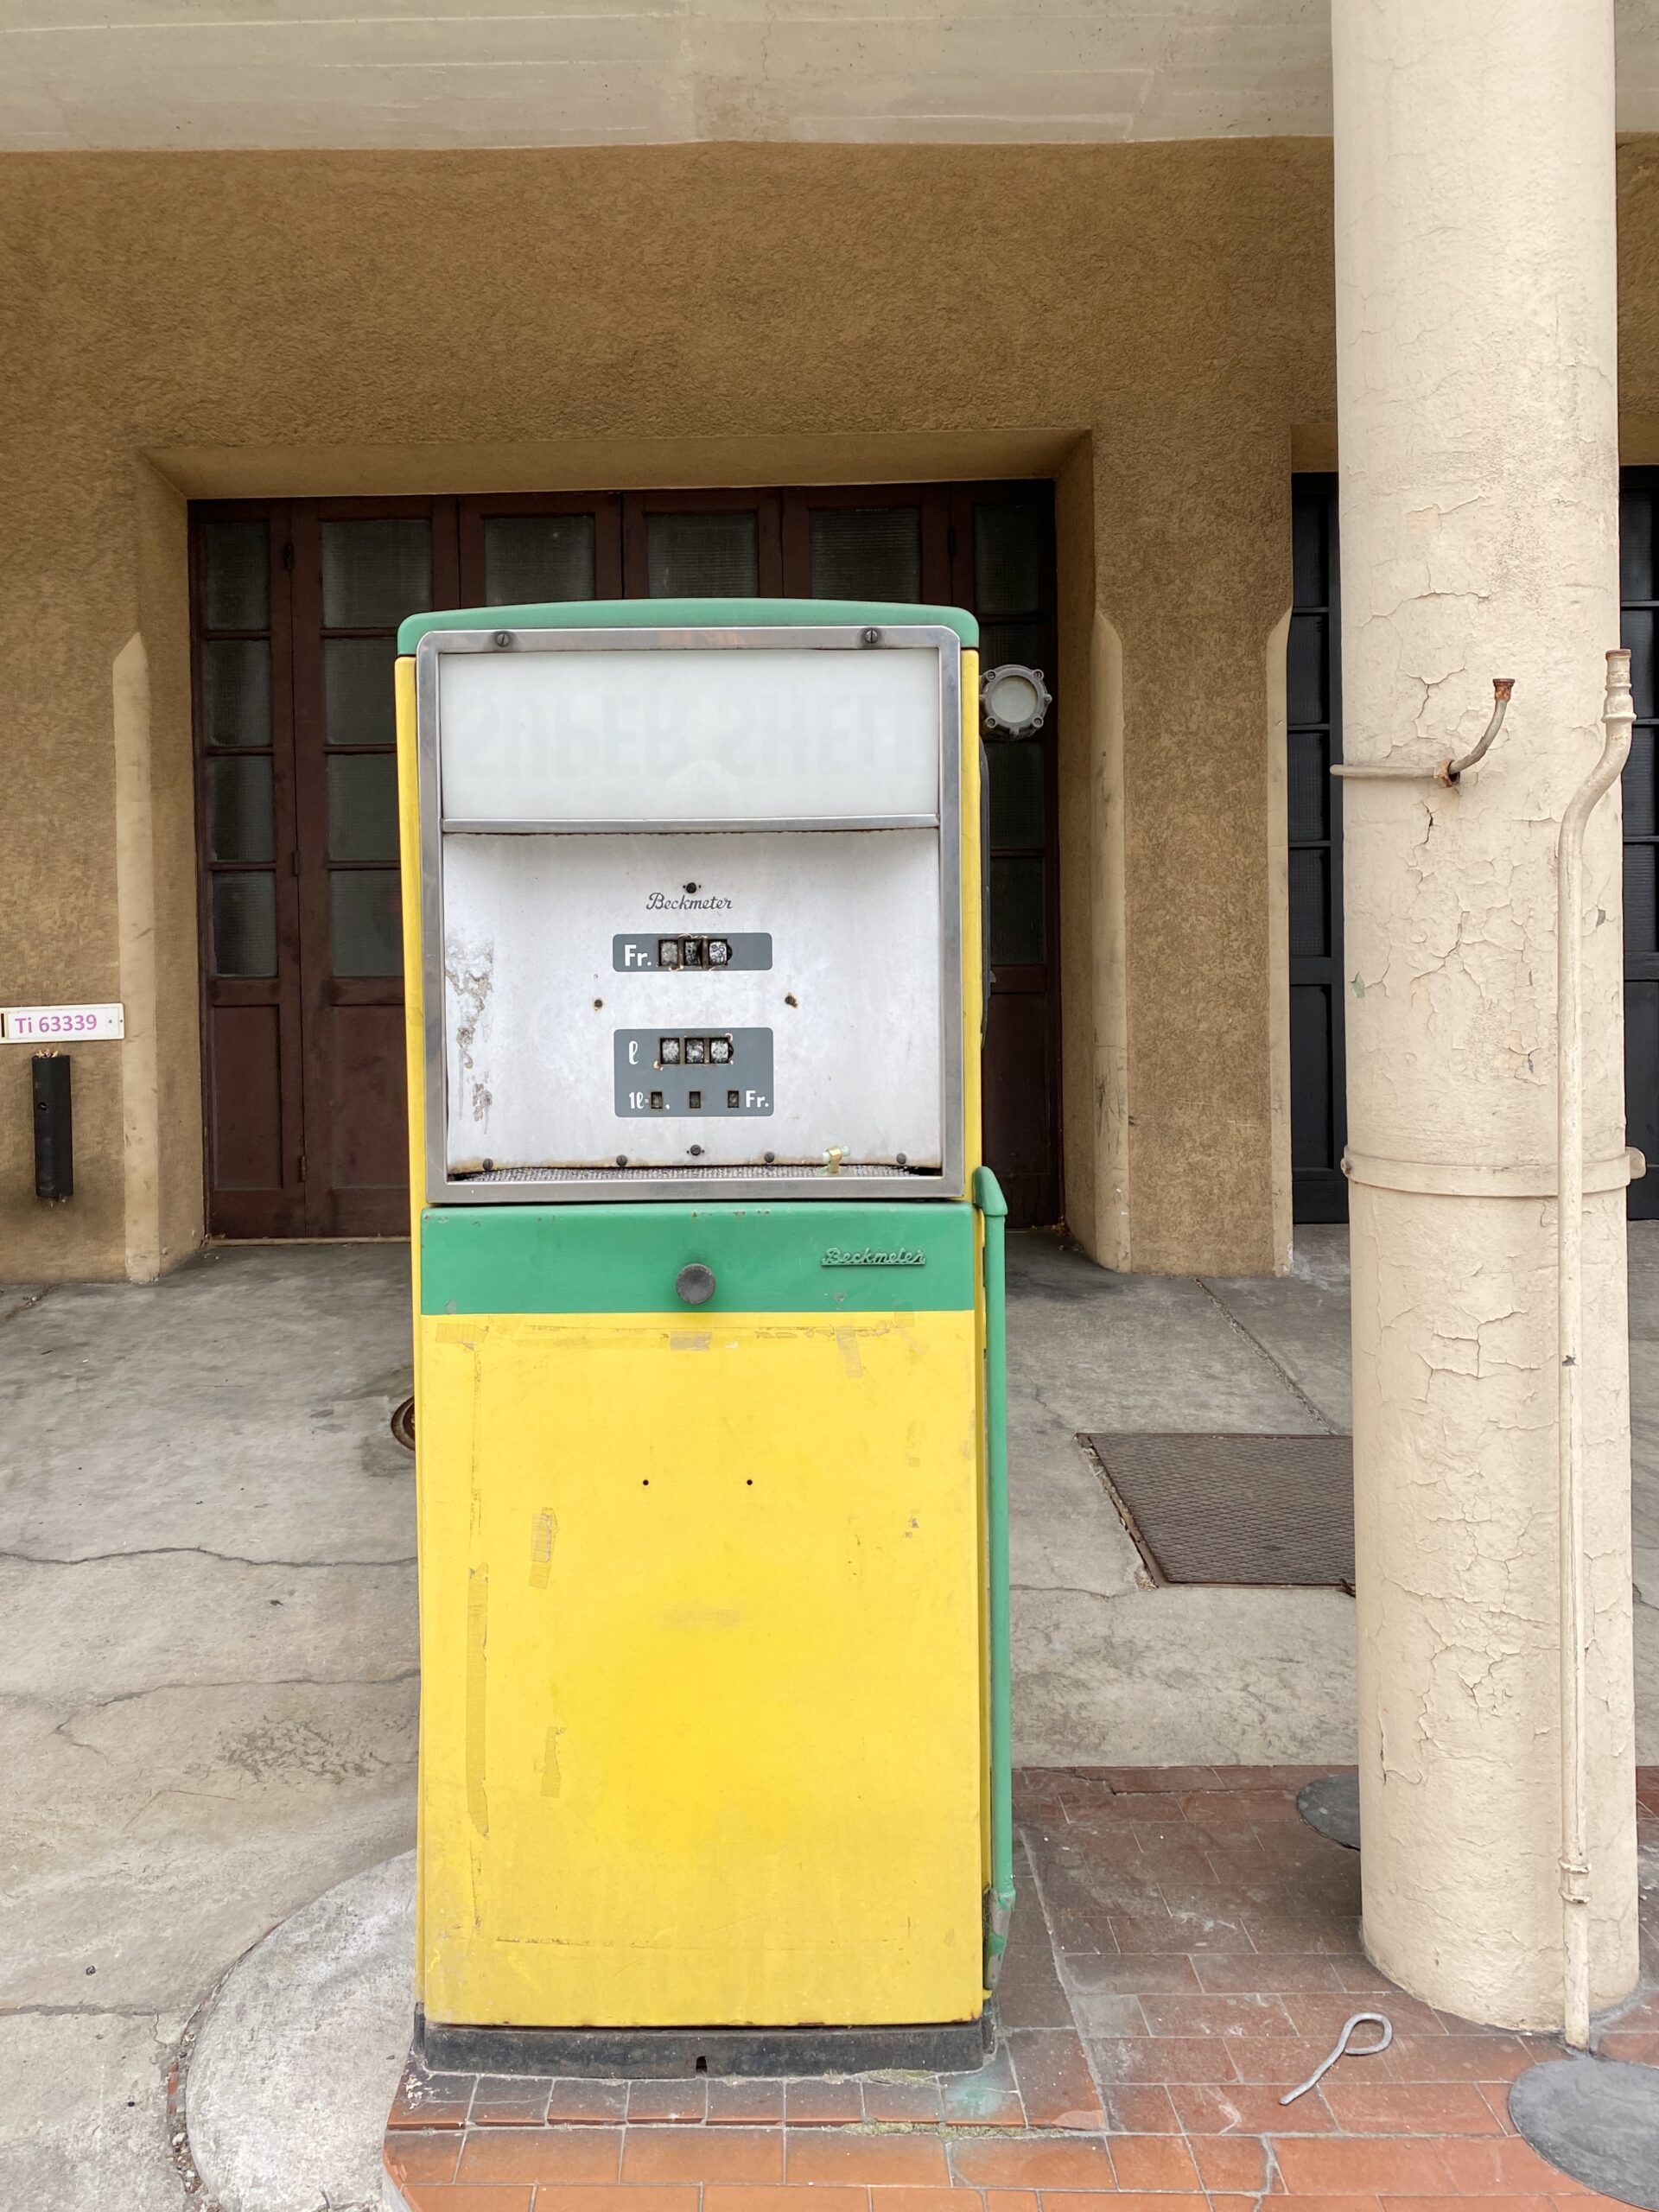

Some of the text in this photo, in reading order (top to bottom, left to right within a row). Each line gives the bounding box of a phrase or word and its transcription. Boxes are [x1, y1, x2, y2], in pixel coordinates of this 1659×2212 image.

[645, 892, 734, 910] Beckmeter
[624, 944, 652, 967] Fr.
[15, 1014, 97, 1033] Ti 63339
[745, 1090, 769, 1108] Fr.
[821, 1247, 926, 1266] Beckmeter
